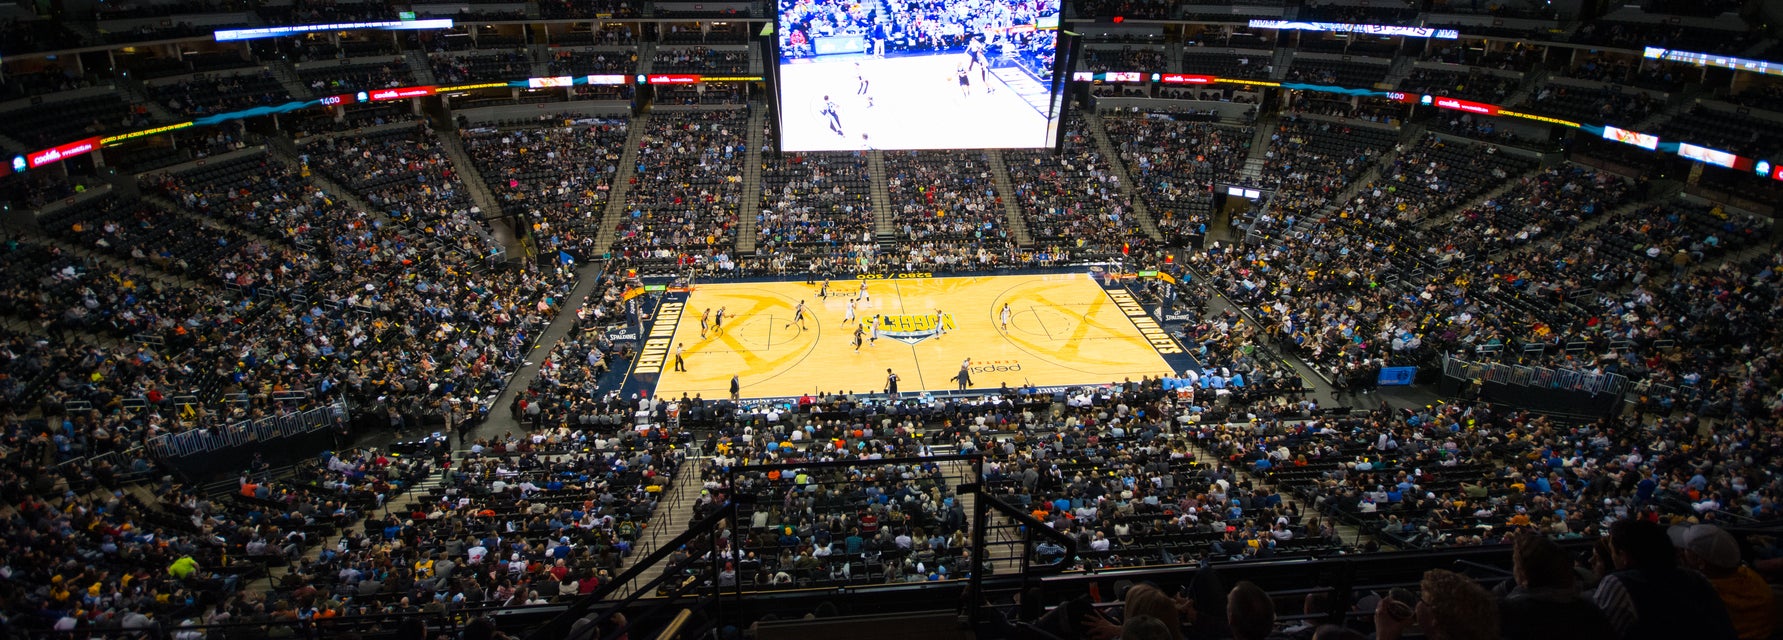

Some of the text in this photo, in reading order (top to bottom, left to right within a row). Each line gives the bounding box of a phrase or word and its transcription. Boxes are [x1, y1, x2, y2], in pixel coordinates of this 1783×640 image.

[320, 96, 340, 105] 1400
[1386, 92, 1404, 100] 1400
[610, 333, 637, 341] SPALDING
[633, 302, 684, 374] DENVER NUGGETS
[1129, 316, 1183, 354] NUGGETS
[970, 363, 1021, 375] pepsi
